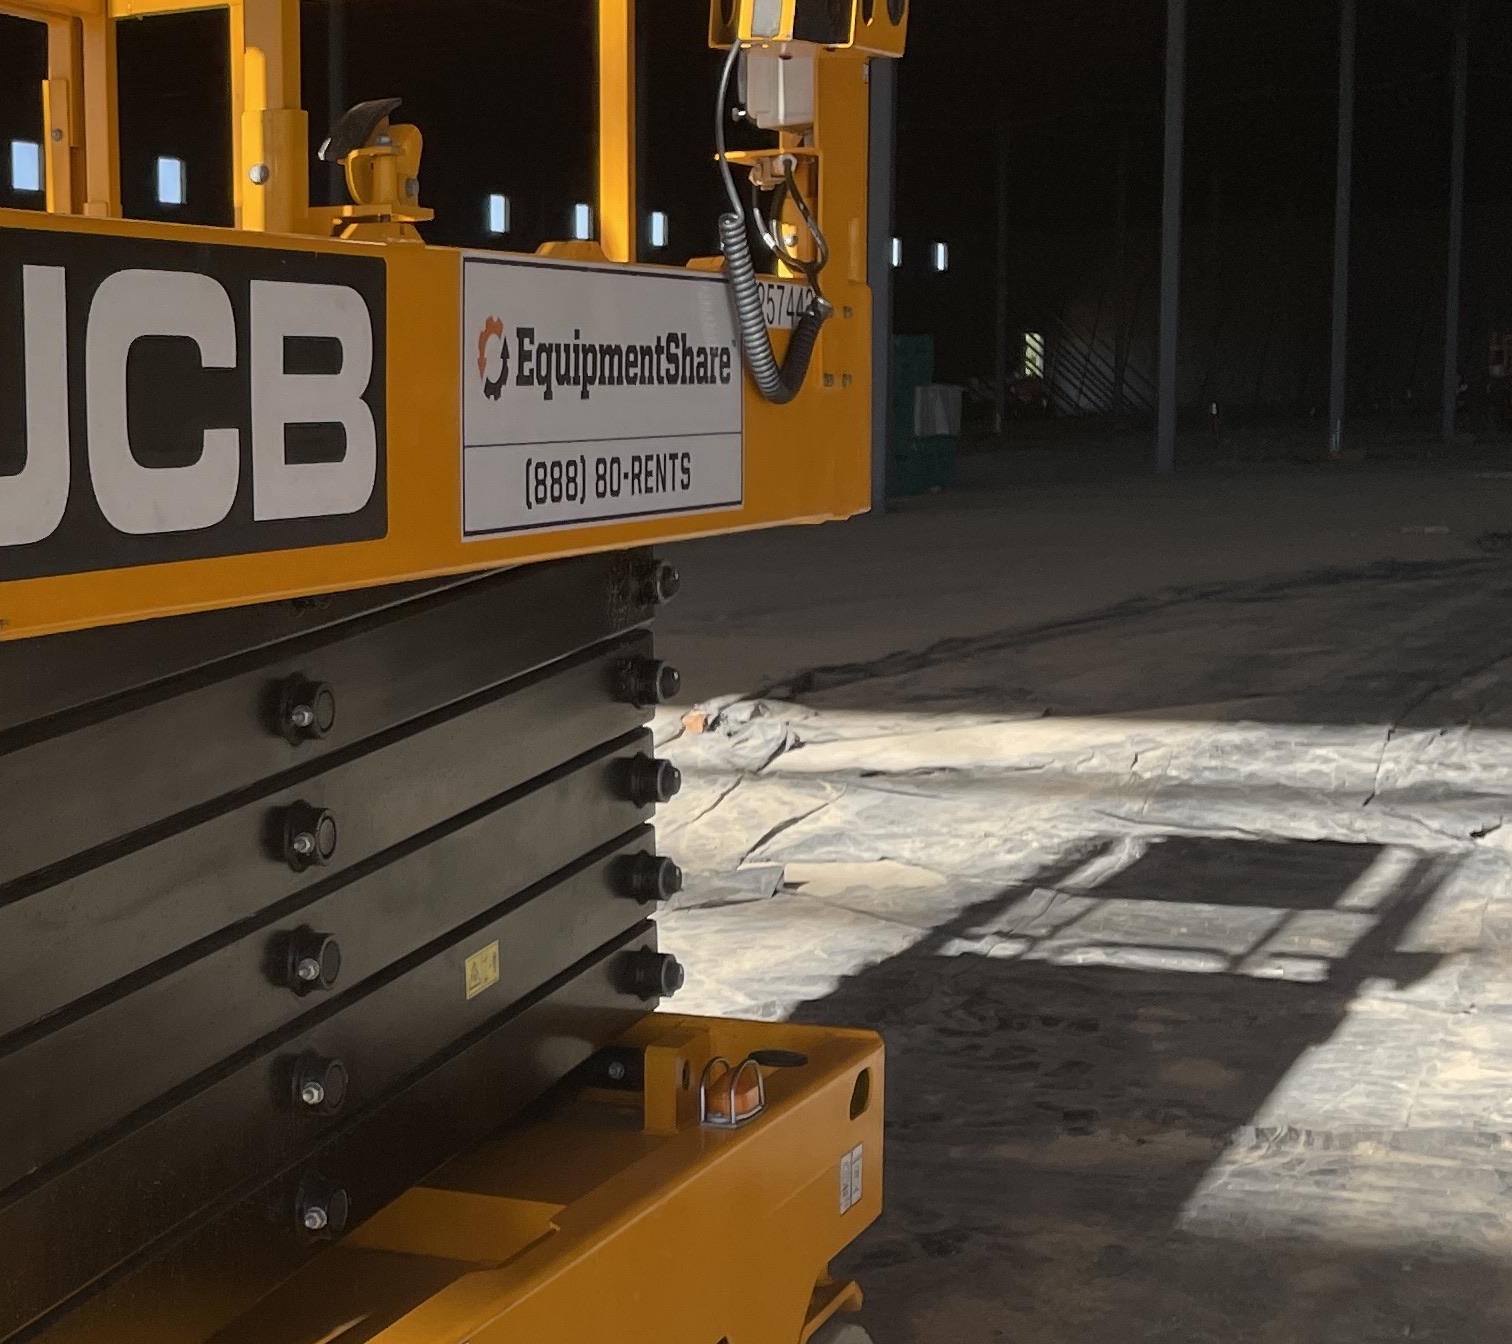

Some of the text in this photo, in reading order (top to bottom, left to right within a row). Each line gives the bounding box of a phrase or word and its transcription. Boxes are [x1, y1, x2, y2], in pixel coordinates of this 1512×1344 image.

[515, 327, 732, 401] EquipmentShare
[525, 452, 691, 510] (888) 80-RENTS
